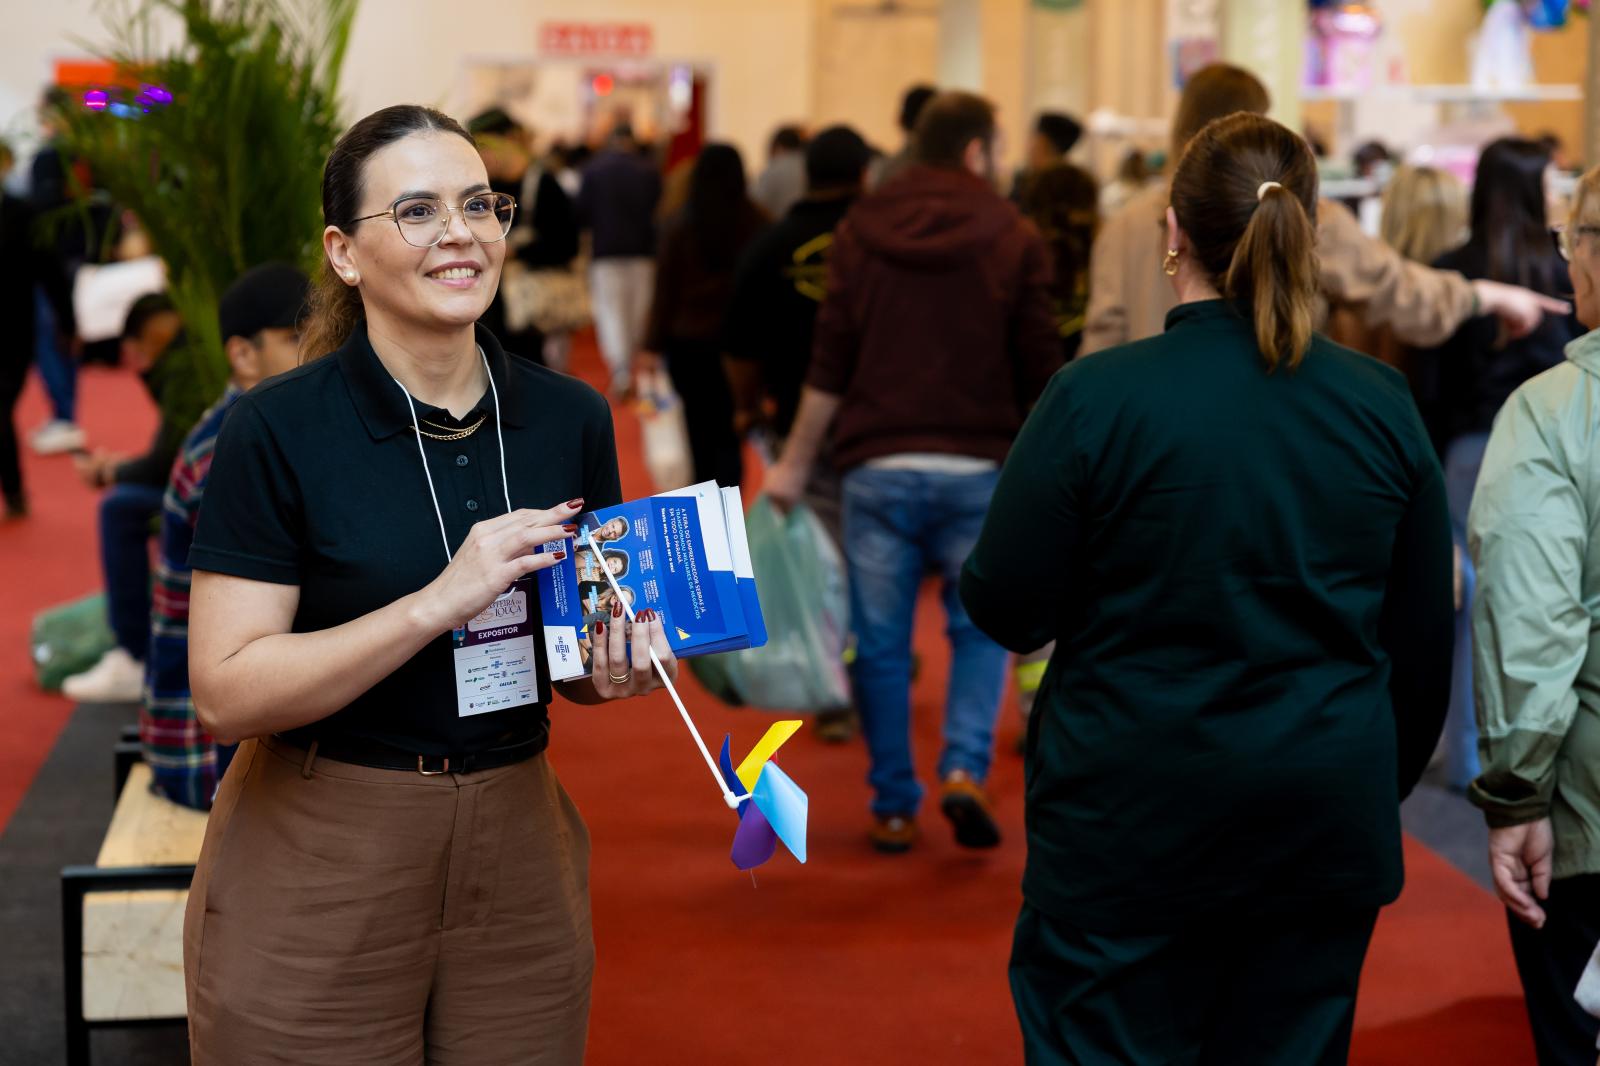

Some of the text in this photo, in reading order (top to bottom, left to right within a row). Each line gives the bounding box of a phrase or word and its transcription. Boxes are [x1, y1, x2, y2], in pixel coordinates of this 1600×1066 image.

[669, 508, 674, 517] EM
[675, 540, 683, 564] PARANÁ
[685, 529, 690, 539] DO
[676, 508, 701, 619] TRANSFORMOU MILHARES DE NEGÓCIOS
[686, 540, 699, 584] EMPREENDEDOR
[496, 599, 515, 608] FEIRA
[695, 585, 704, 606] SEBRAE
[496, 605, 521, 617] LOUÇA
[478, 626, 518, 640] EXPOSITOR
[558, 635, 567, 663] SEBRAE
